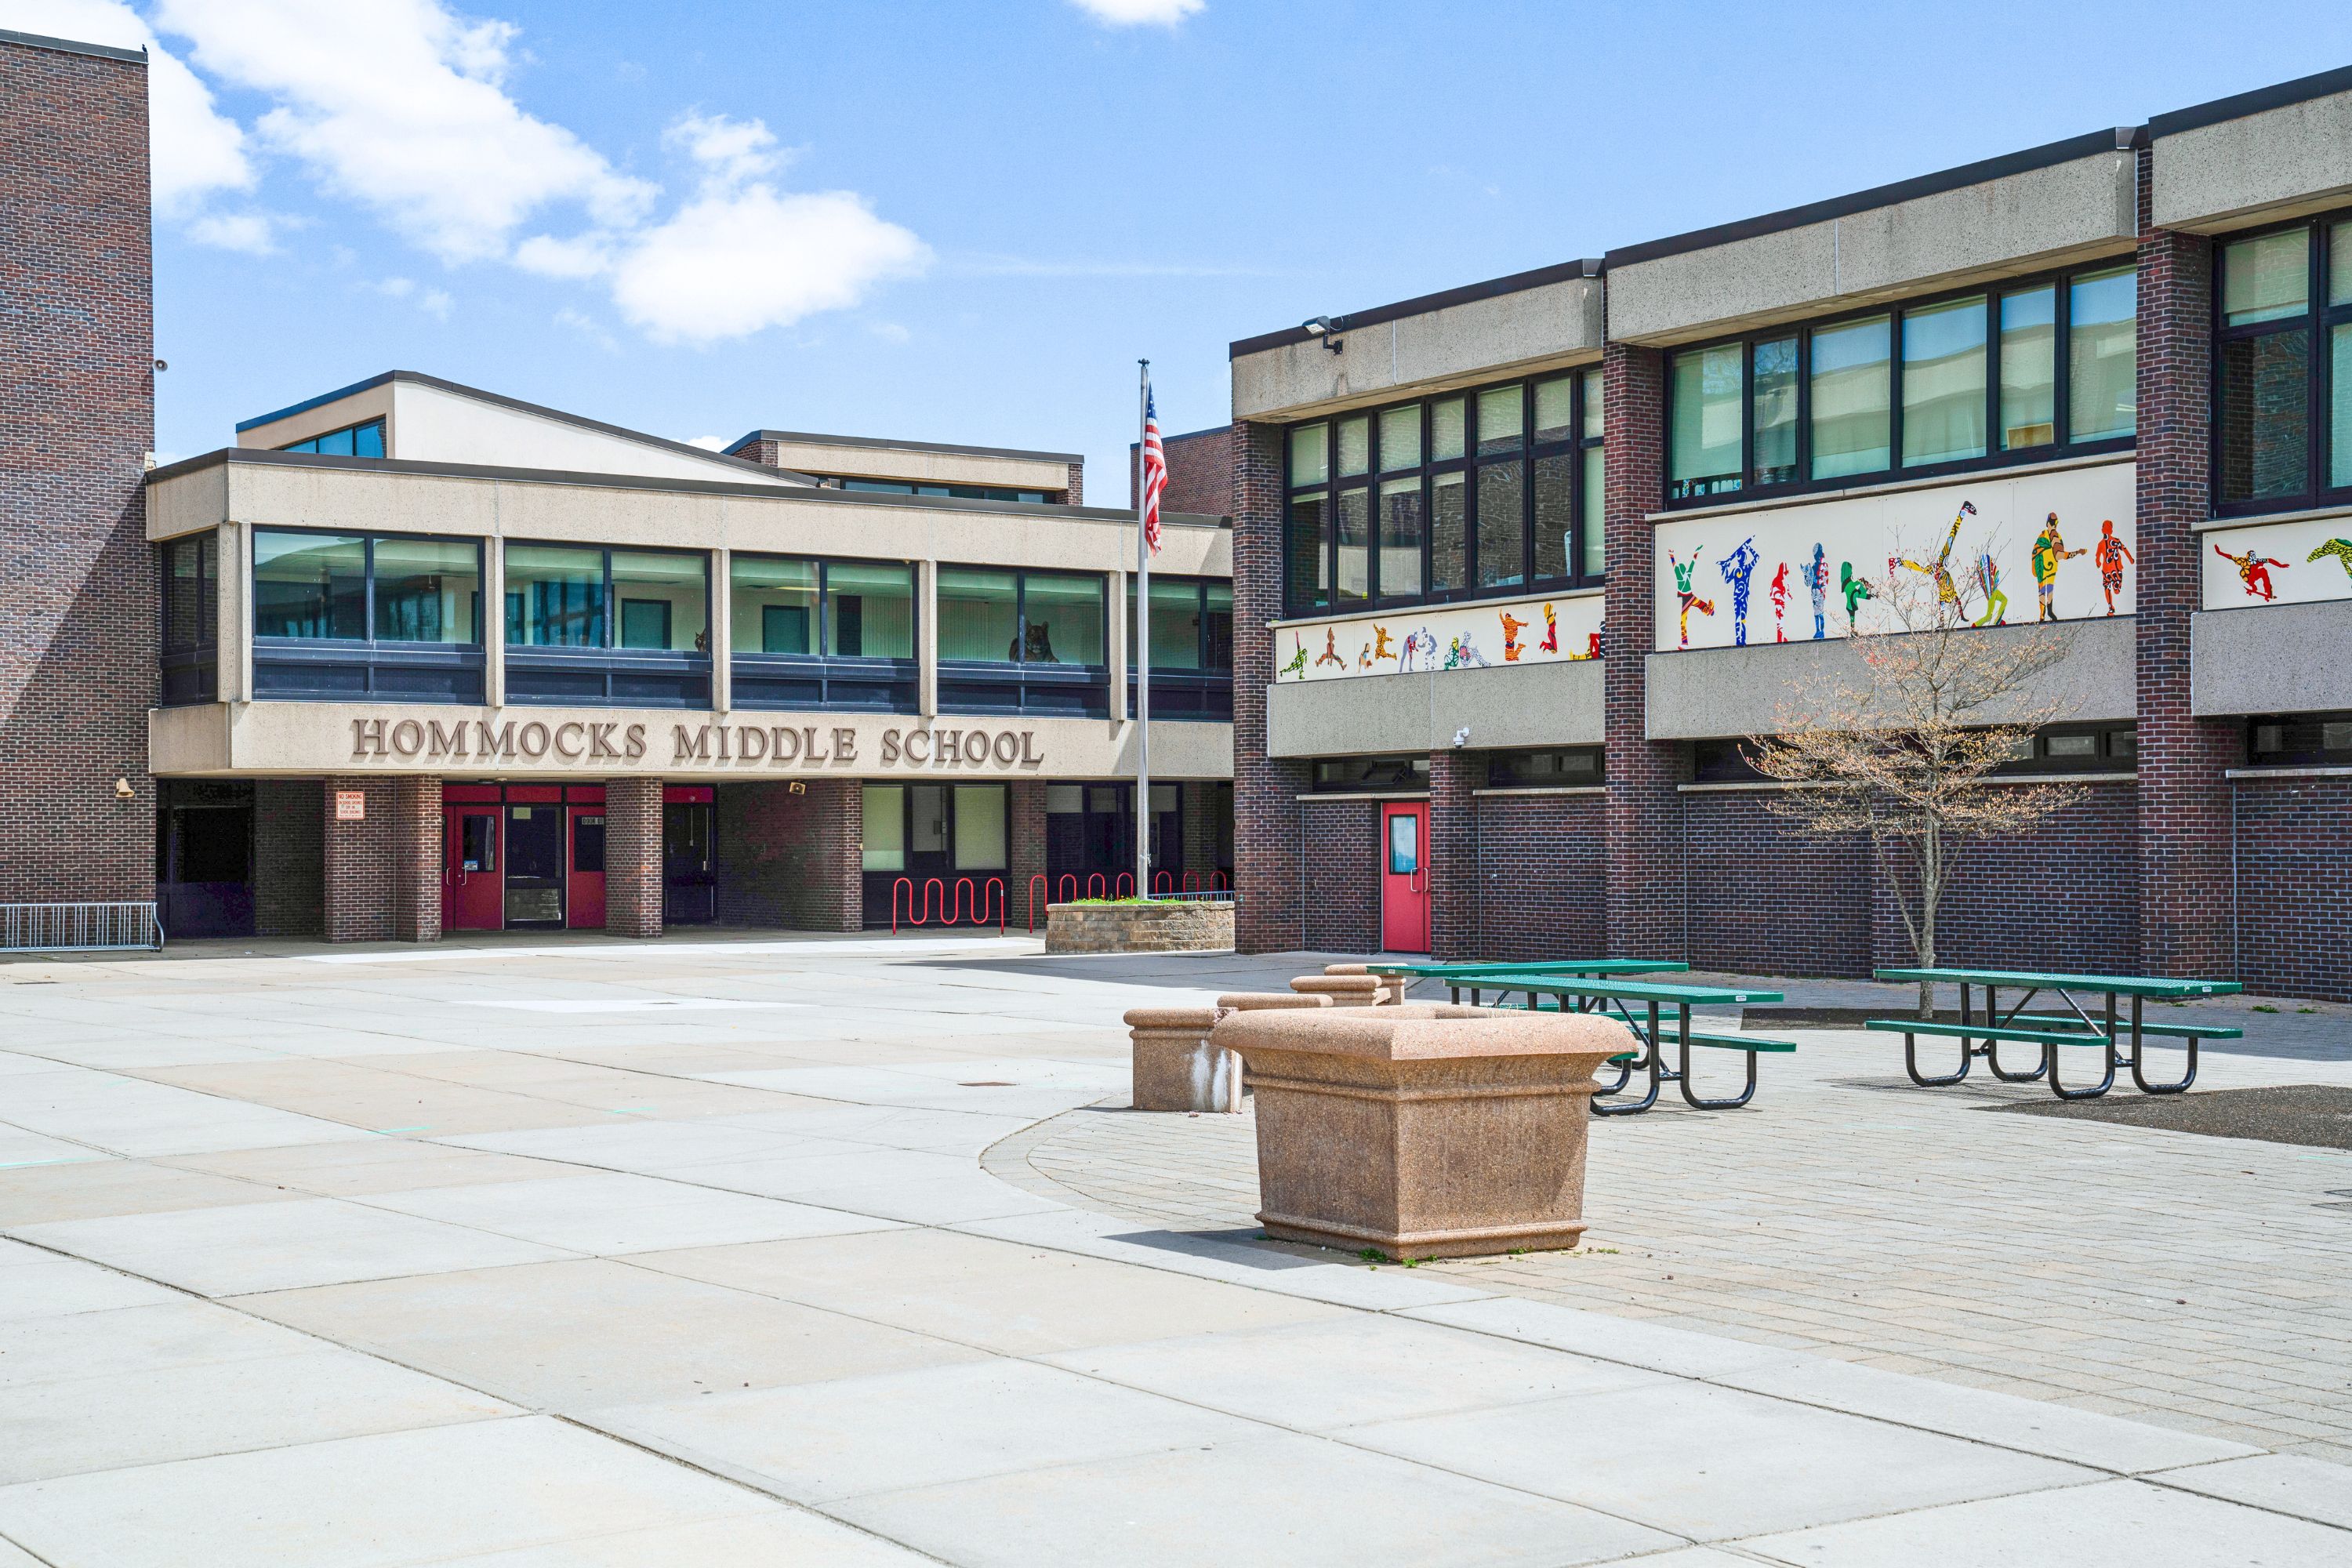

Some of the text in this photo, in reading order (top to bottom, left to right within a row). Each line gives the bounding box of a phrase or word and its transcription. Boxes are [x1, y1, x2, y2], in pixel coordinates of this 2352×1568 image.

[353, 719, 1044, 764] HOMMOCKS MIDDLE SCHOOL
